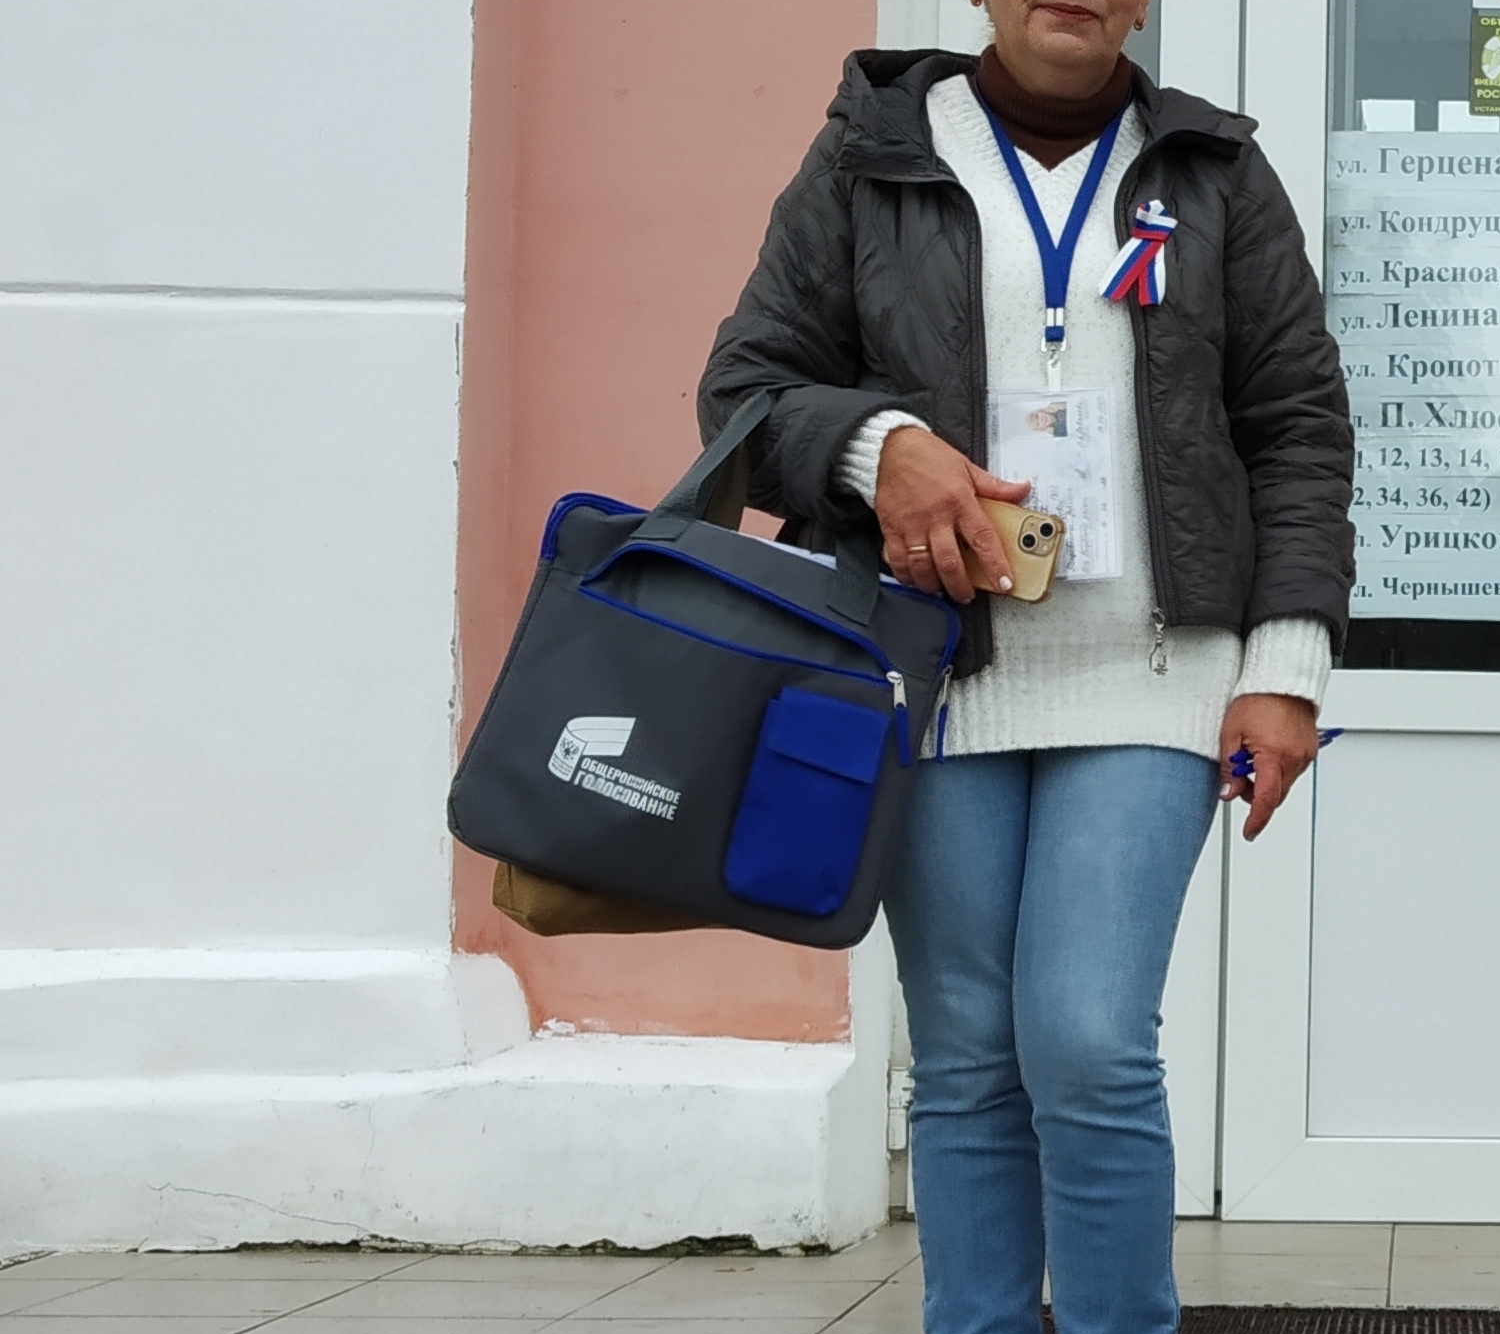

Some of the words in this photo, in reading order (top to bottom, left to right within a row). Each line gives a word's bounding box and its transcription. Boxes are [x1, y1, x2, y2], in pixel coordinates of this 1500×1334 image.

[1336, 159, 1368, 178] ул.
[1339, 215, 1372, 234] ул.
[1339, 269, 1372, 287] ул.
[1339, 316, 1372, 334] ул.
[1376, 302, 1499, 328] Ленина
[1345, 363, 1376, 382] ул.
[1379, 402, 1414, 428] П.
[1379, 447, 1410, 471] 12,
[1419, 447, 1450, 470] 13,
[1459, 448, 1490, 470] 14,
[1375, 486, 1409, 510] 34,
[1415, 488, 1449, 511] 36,
[1455, 487, 1491, 512] 42)
[580, 756, 682, 805] ОБЩЕРОССИЙСКОЕ
[573, 769, 678, 821] ГОЛОСОВАНИЕ
